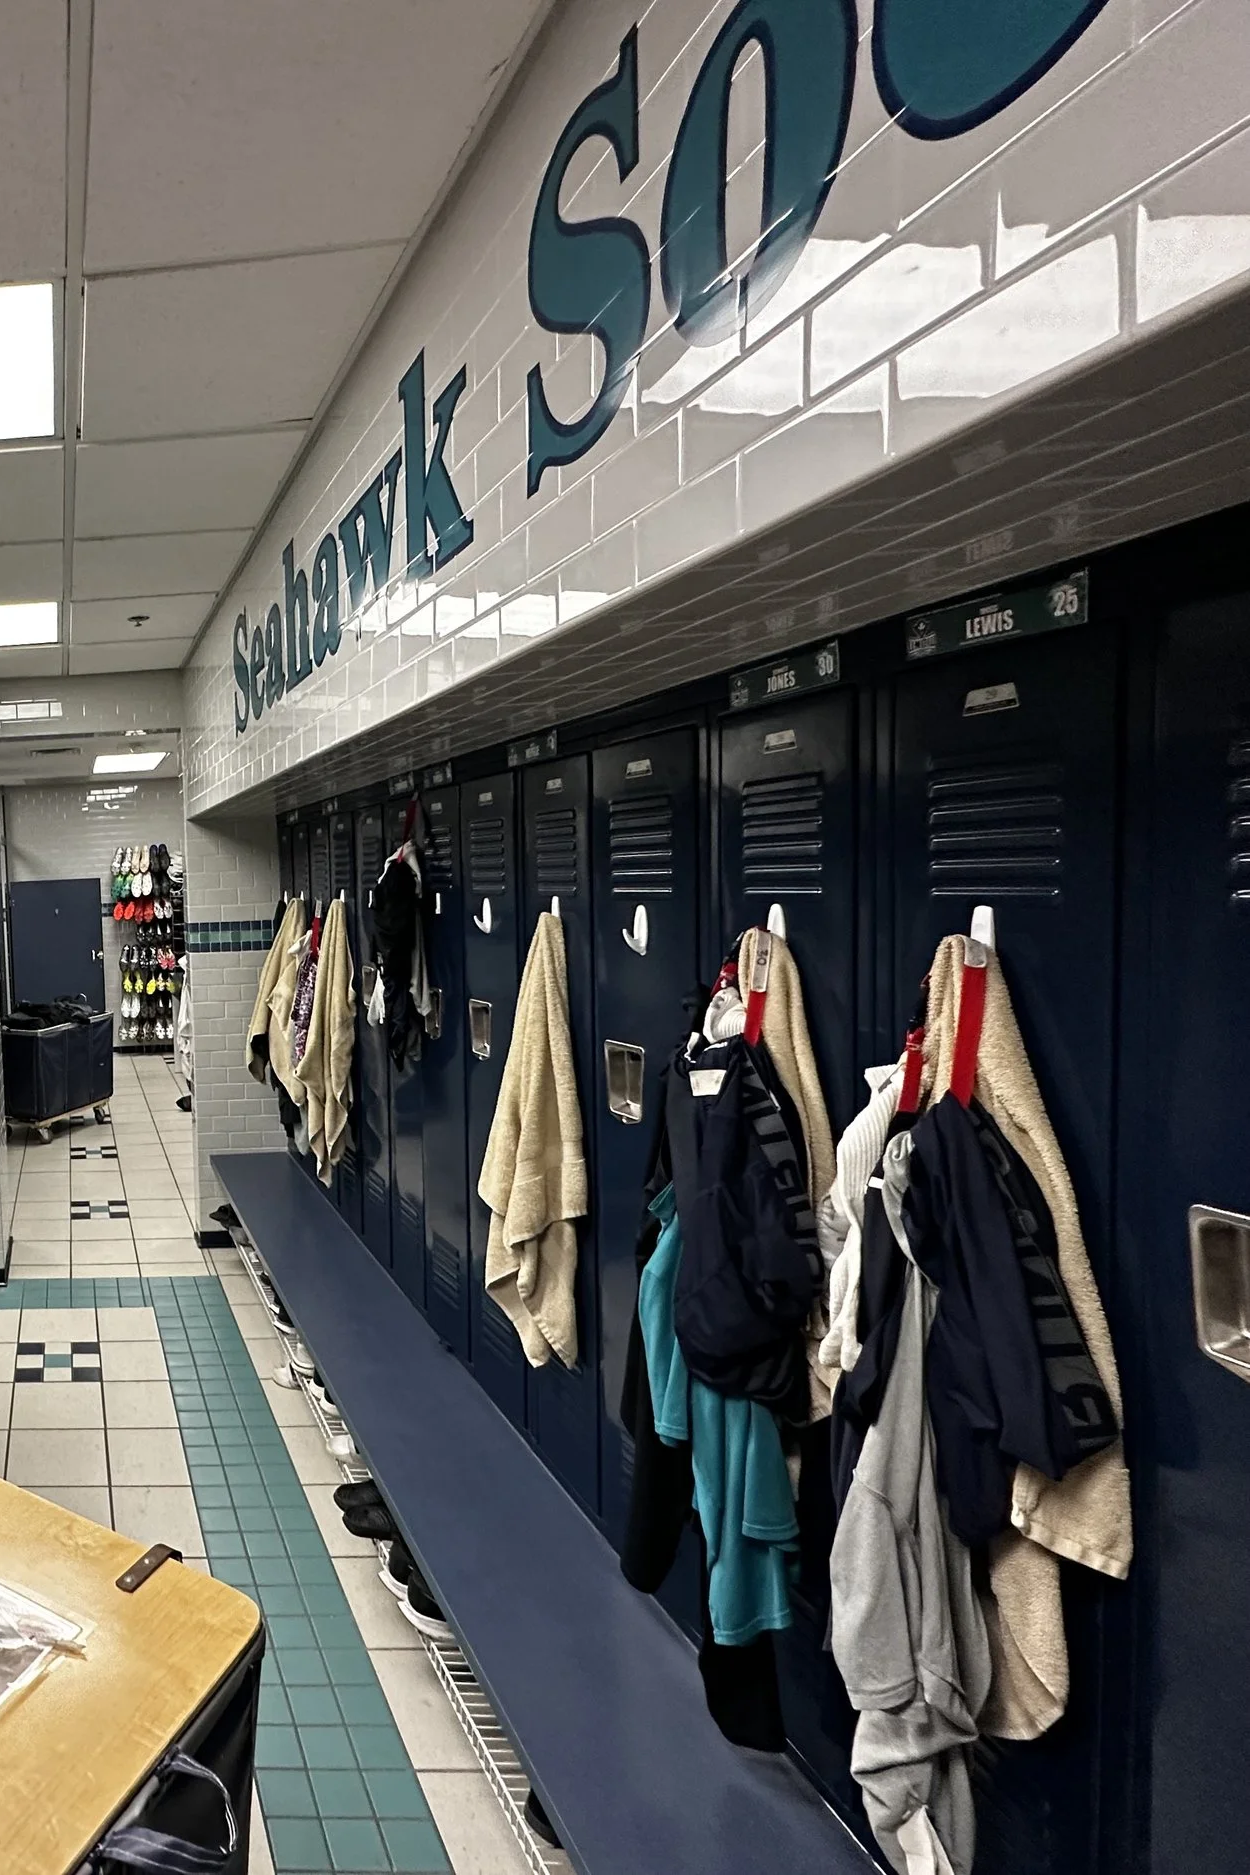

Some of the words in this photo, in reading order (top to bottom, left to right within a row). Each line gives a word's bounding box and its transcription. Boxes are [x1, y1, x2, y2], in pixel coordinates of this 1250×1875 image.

[233, 346, 474, 738] Seahawk
[966, 609, 1014, 639] LEWIS
[1053, 587, 1079, 617] 25
[767, 670, 796, 694] JONES
[818, 654, 834, 677] 30
